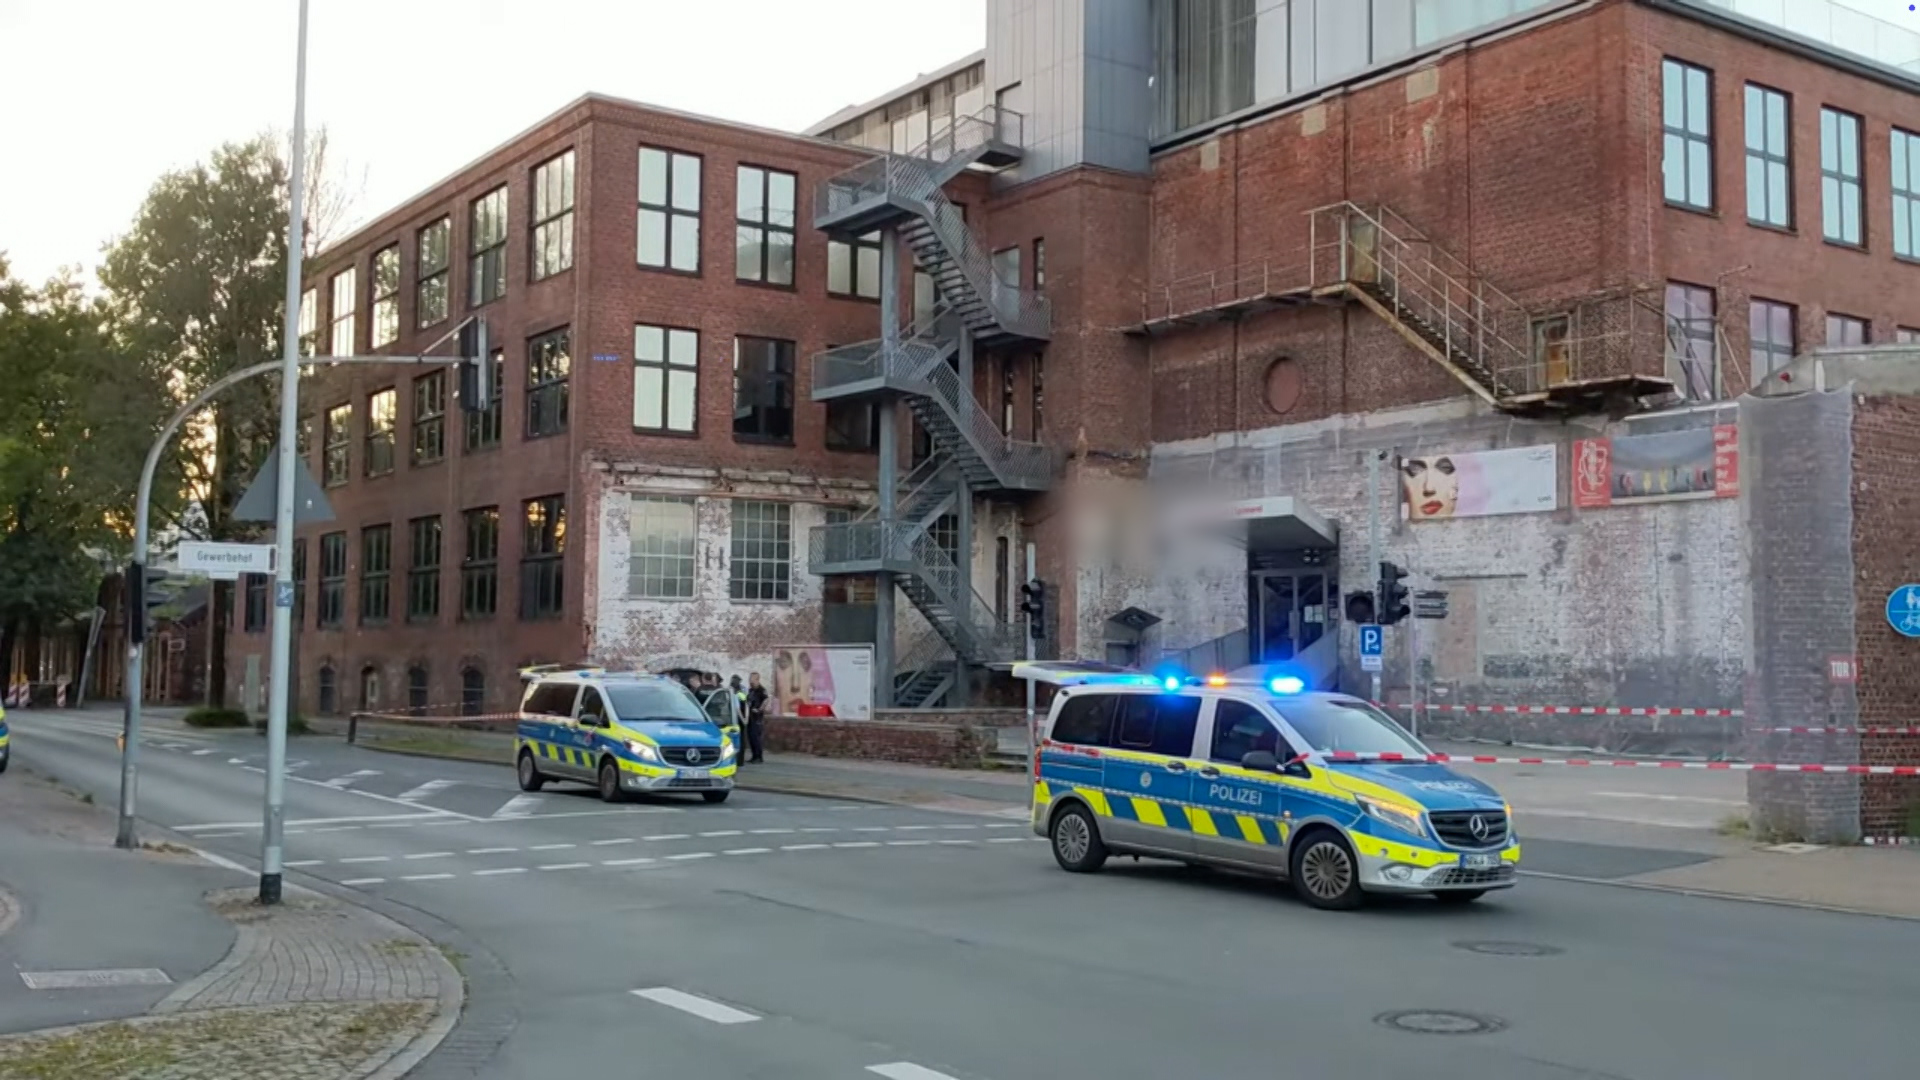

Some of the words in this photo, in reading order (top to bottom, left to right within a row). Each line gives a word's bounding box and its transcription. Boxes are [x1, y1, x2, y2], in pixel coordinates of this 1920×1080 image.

[197, 551, 253, 563] Gewerbehof
[1365, 630, 1377, 652] P
[1209, 784, 1262, 805] POLIZEI
